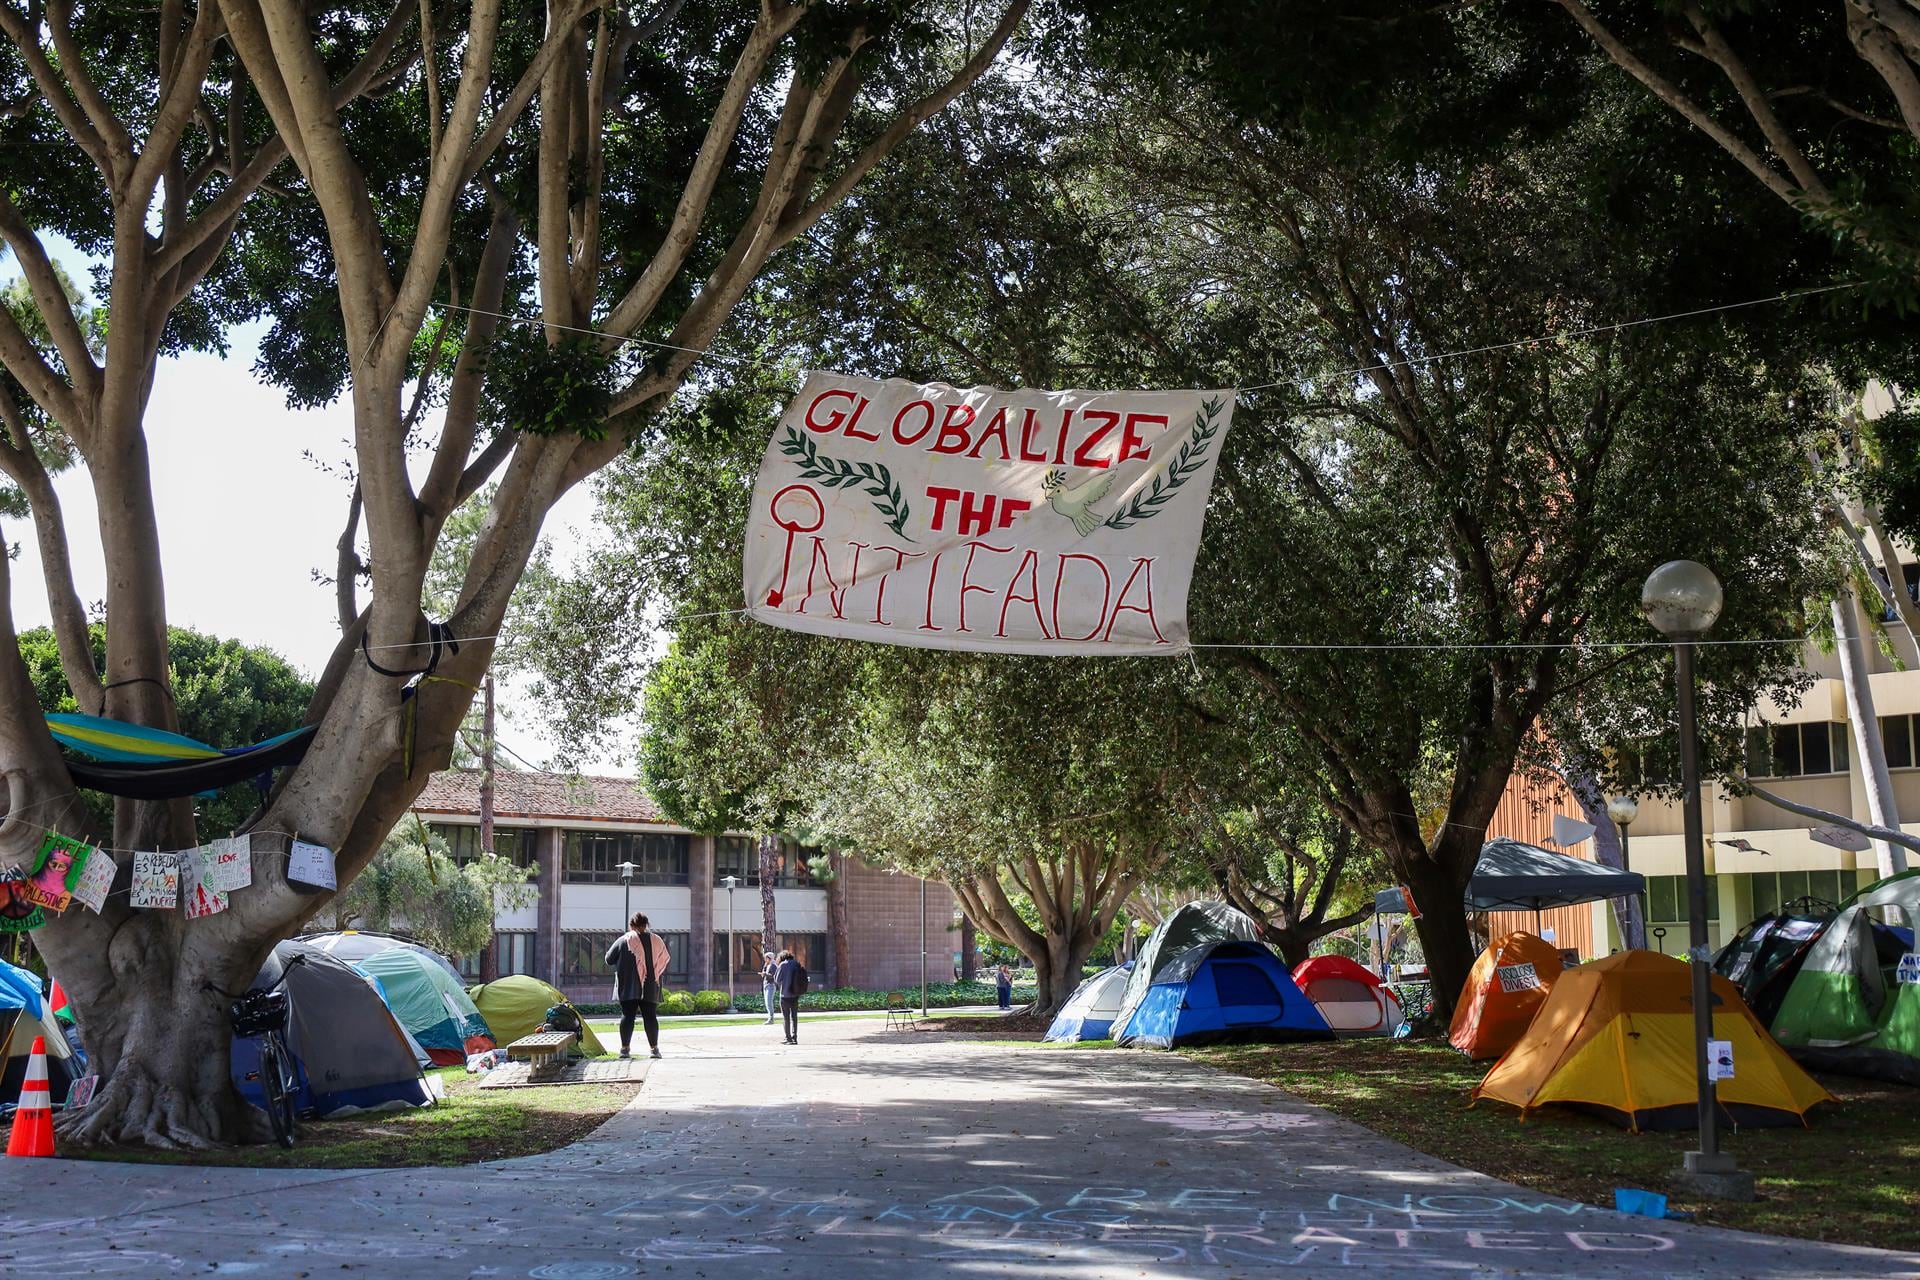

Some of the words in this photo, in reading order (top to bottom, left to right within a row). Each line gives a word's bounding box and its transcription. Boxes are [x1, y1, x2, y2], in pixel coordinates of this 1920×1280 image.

[805, 389, 1169, 468] GLOBALIZE
[925, 486, 1032, 537] THE
[767, 484, 1170, 644] INTIFADA
[43, 835, 87, 861] FREE
[135, 853, 149, 862] LA
[134, 863, 149, 873] ES
[152, 868, 166, 876] LA
[24, 884, 67, 909] PALESTINE
[138, 897, 149, 906] LA
[1503, 976, 1536, 991] DIVEST
[925, 1185, 1261, 1209] ARE
[1327, 1193, 1585, 1215] NOW
[812, 1214, 1677, 1252] LIBERATED
